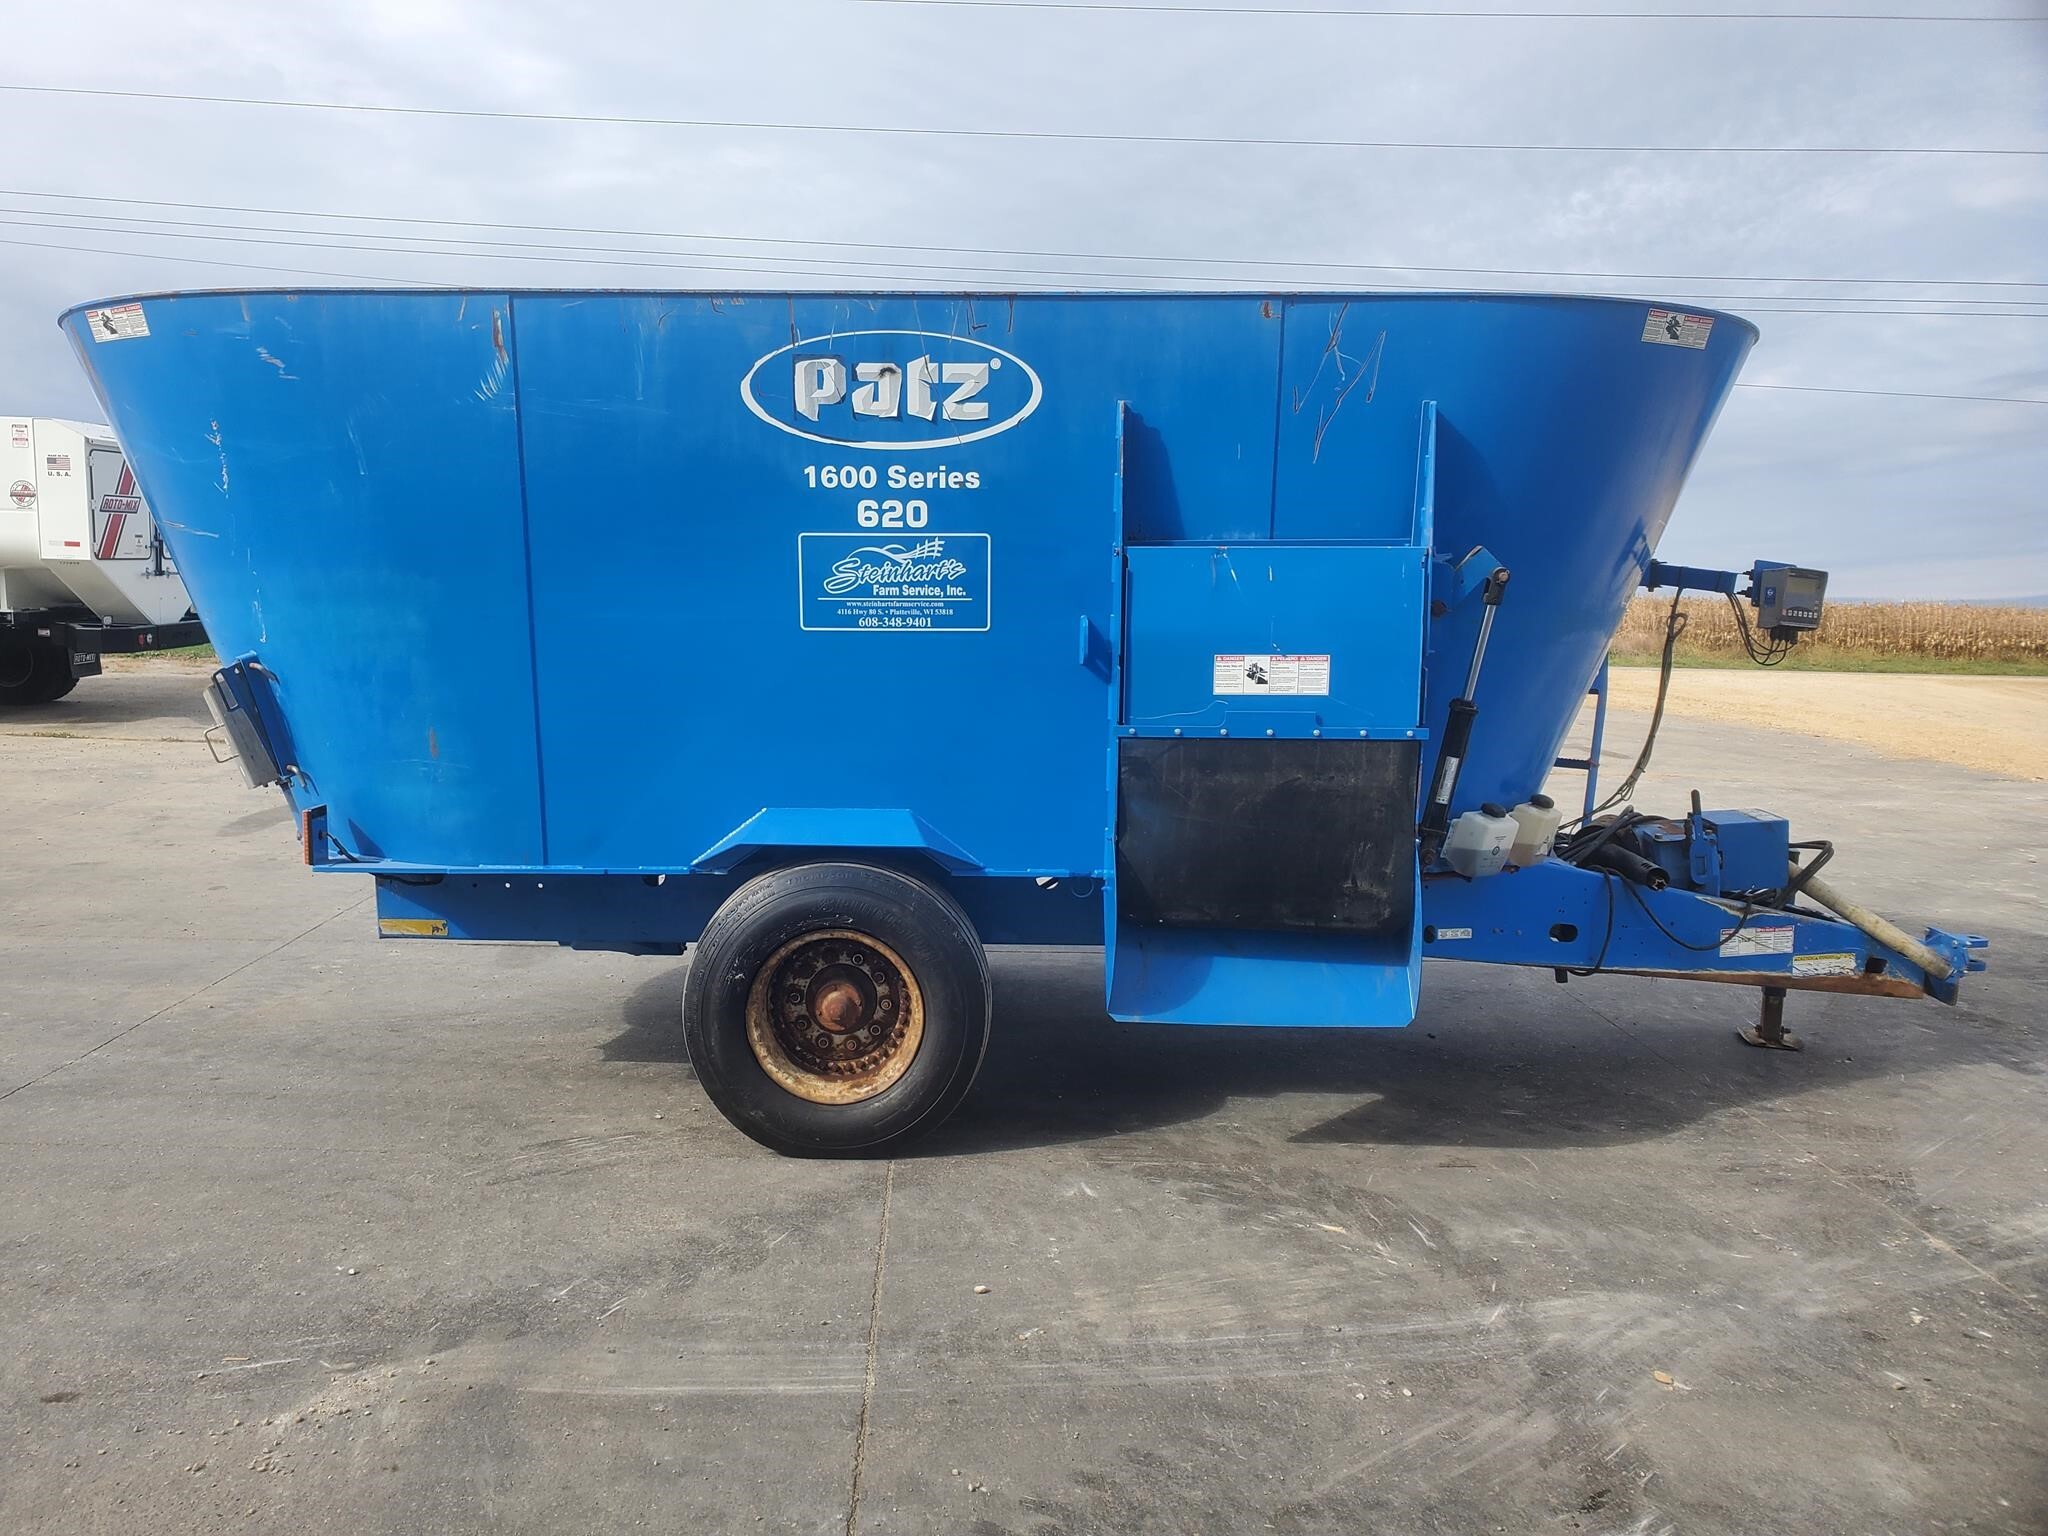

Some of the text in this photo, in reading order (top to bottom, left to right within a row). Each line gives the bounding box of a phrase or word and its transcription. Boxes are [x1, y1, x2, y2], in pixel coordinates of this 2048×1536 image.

[804, 465, 981, 488] 1600 Series
[102, 498, 138, 511] ROTO-MIX
[857, 500, 928, 527] 620
[824, 557, 967, 594] Steinhart's
[873, 585, 966, 598] Farm Service, Inc.
[859, 617, 932, 627] 608-348-9401
